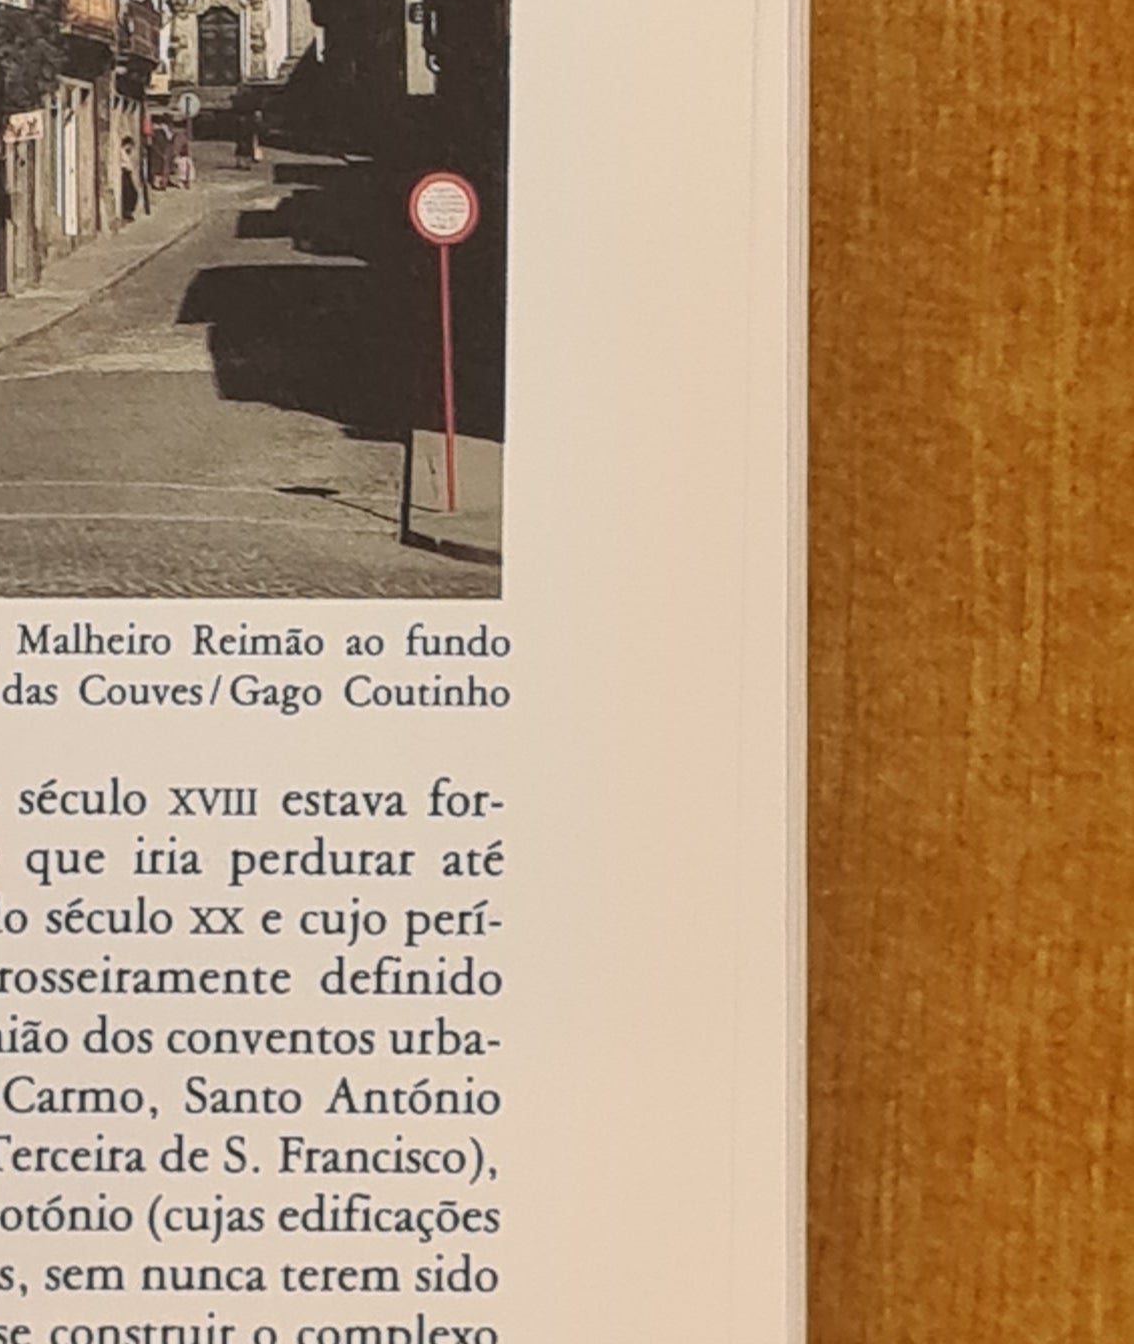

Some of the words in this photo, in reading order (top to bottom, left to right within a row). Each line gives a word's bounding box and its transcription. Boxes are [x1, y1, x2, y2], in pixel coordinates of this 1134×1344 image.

[16, 621, 172, 656] Malheiro
[191, 622, 325, 657] Reimão
[345, 634, 385, 657] ao
[405, 621, 512, 658] fundo
[1, 671, 59, 707] das
[343, 673, 511, 708] Coutinho
[18, 775, 148, 817] século
[167, 787, 258, 817] XVIII
[281, 788, 408, 818] estava
[426, 776, 505, 819] for-
[45, 895, 174, 936] século
[189, 905, 245, 935] XX
[260, 909, 283, 936] e
[299, 896, 388, 948] cujo
[403, 898, 503, 948] perí-
[319, 954, 503, 997] definido
[2, 1074, 159, 1120] Carmo,
[184, 1075, 303, 1115] Santo
[324, 1075, 502, 1116] António
[159, 1132, 210, 1174] de
[223, 1134, 260, 1175] S.
[277, 1133, 498, 1186] Francisco),
[44, 1264, 126, 1292] sem
[140, 1265, 268, 1293] nunca
[280, 1263, 402, 1293] terem
[414, 1252, 499, 1294] sido
